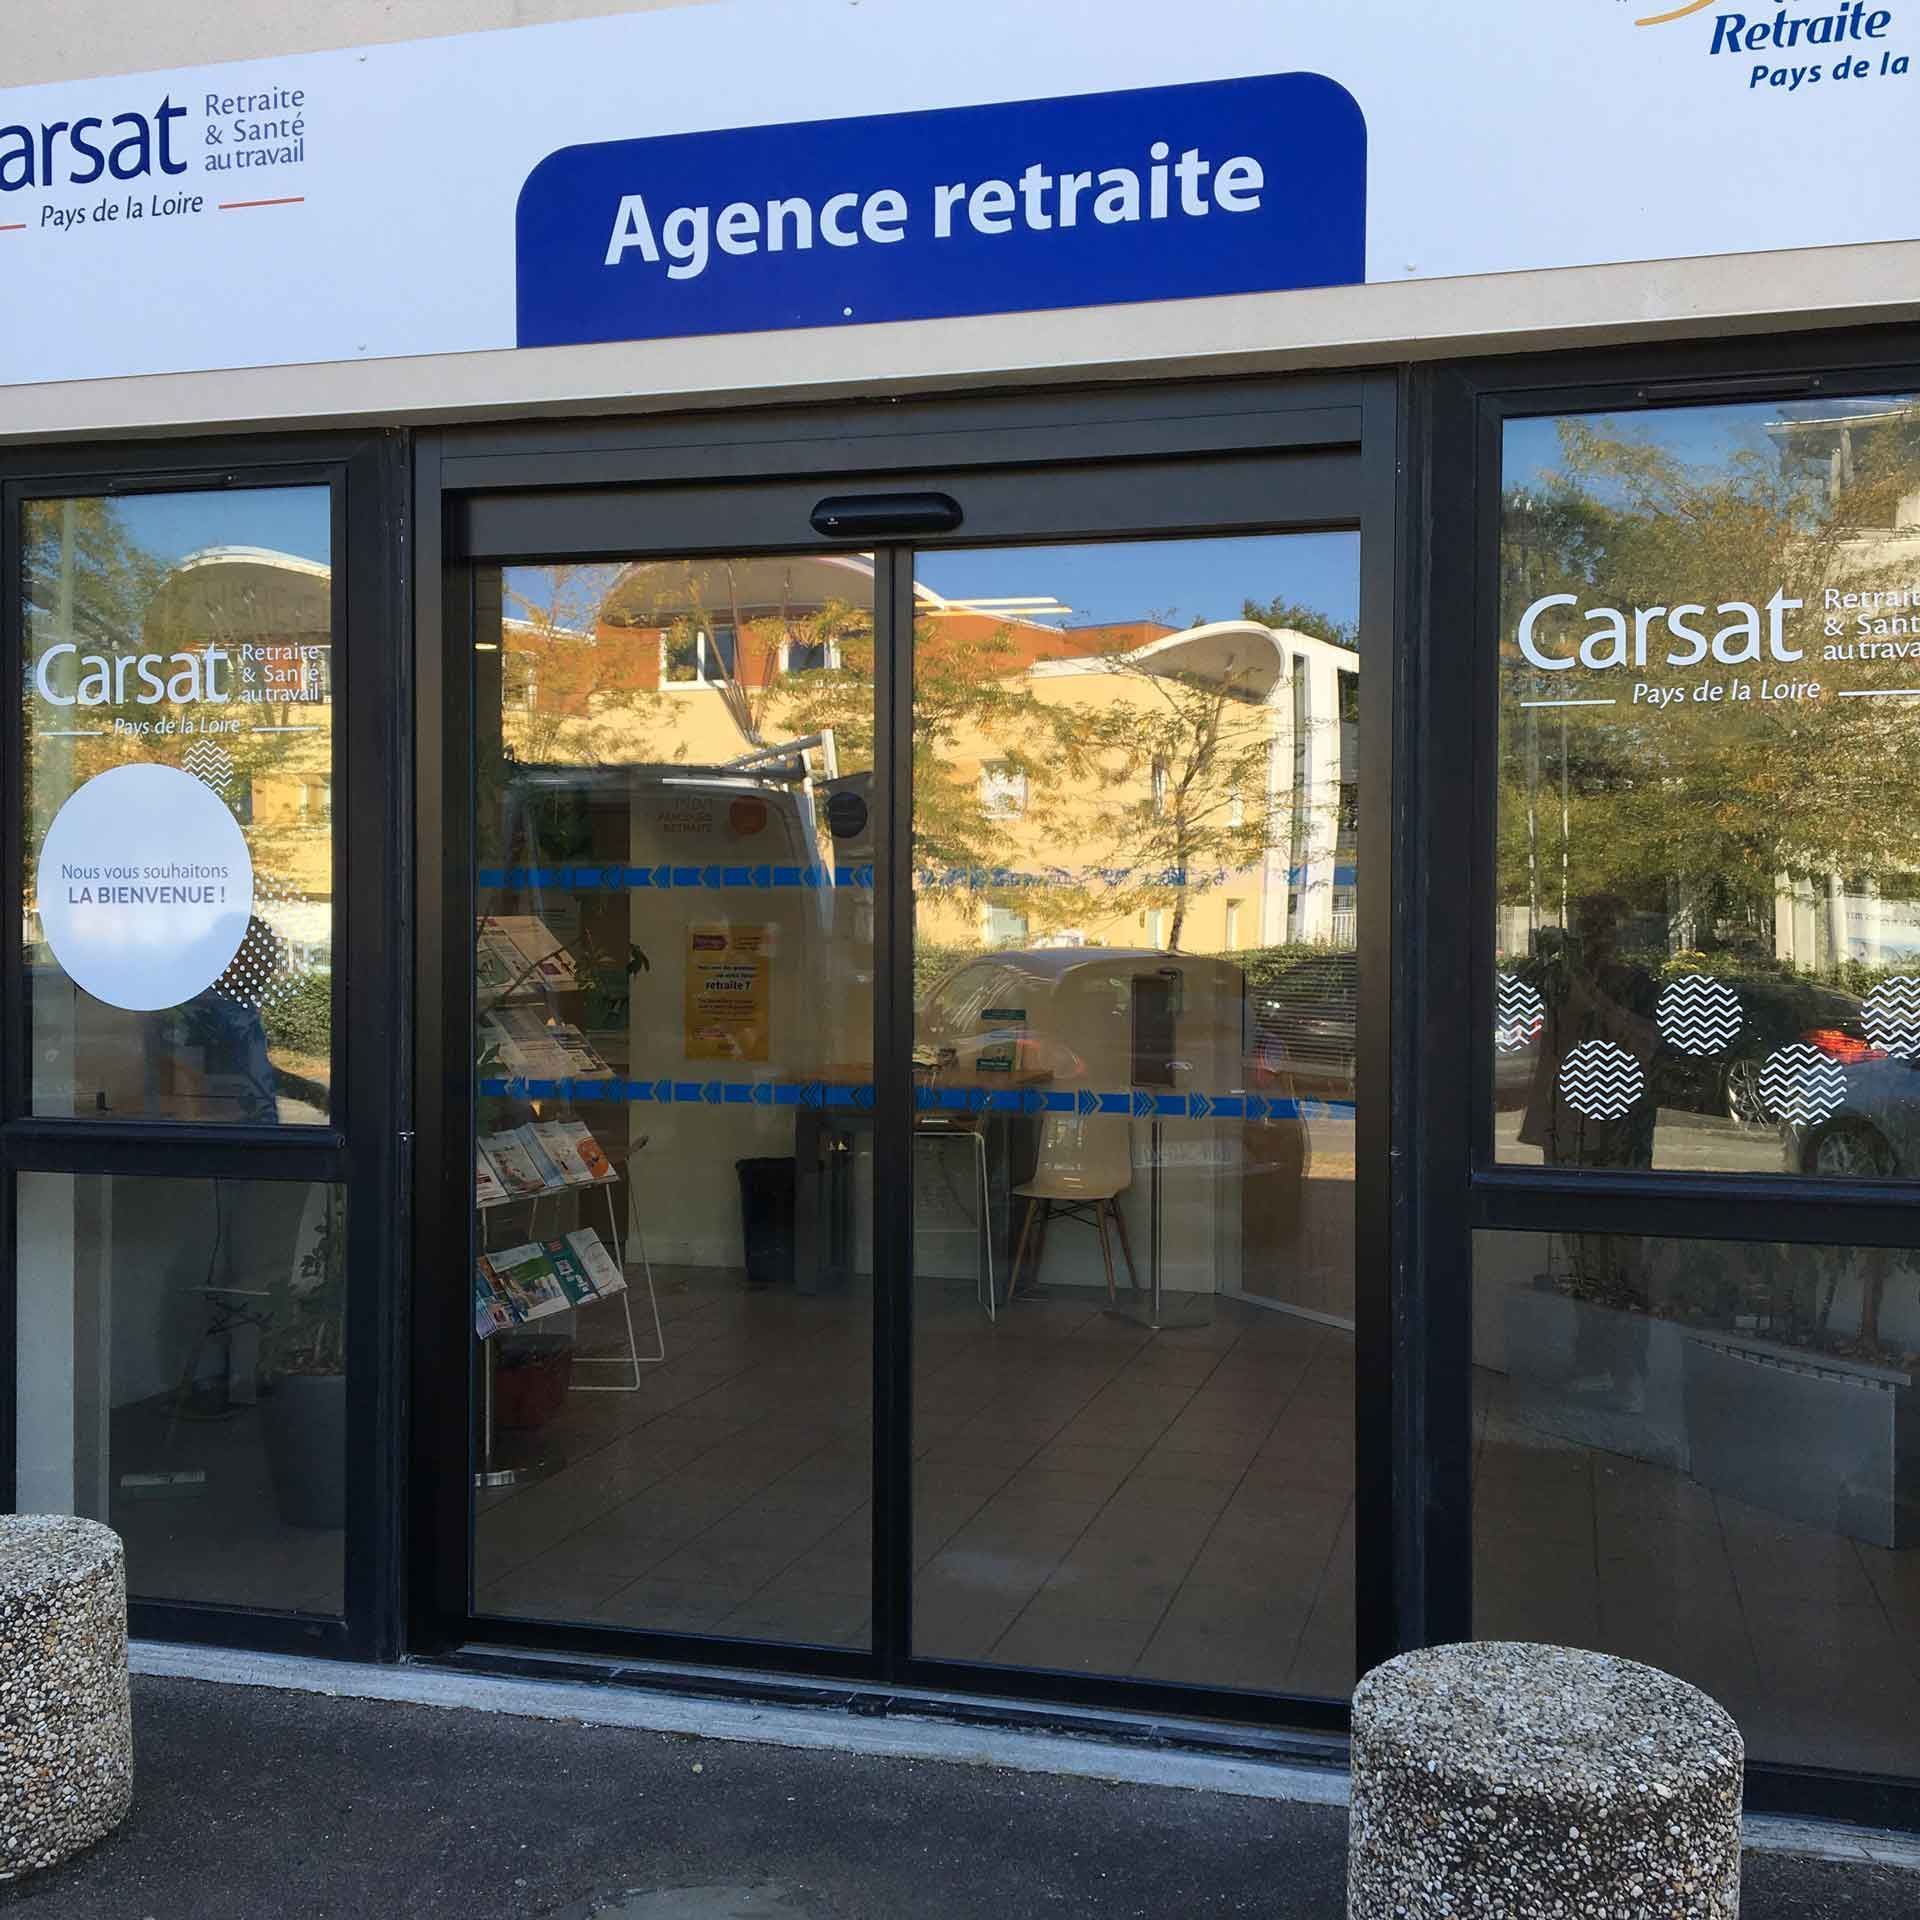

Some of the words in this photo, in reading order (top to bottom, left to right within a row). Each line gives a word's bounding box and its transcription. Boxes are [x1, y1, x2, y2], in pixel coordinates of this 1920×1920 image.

[1710, 1, 1892, 54] Retraite
[1750, 65, 1822, 91] Pays
[1832, 55, 1870, 81] de
[1880, 51, 1910, 76] la
[205, 87, 305, 117] Retraite
[205, 125, 223, 145] &
[233, 112, 305, 143] Santé
[41, 205, 86, 231] Pays
[93, 198, 119, 222] de
[126, 196, 144, 219] la
[151, 192, 204, 217] Loire
[604, 189, 908, 280] Agence
[934, 141, 1265, 238] retraite
[1518, 585, 1803, 671] Carsat
[1824, 617, 1844, 637] &
[242, 642, 319, 661] Retraite
[37, 642, 229, 706] Carsat
[242, 668, 256, 683] &
[264, 664, 319, 683] Santé
[1633, 683, 1685, 709] Pays
[1693, 680, 1723, 702] de
[1732, 679, 1751, 701] la
[1761, 677, 1821, 701] Loire
[114, 718, 149, 737] Pays
[154, 716, 176, 734] de
[180, 716, 194, 733] la
[200, 716, 240, 733] Loire
[62, 864, 100, 880] Nous
[103, 867, 139, 880] vous
[144, 862, 228, 879] souhaitons
[69, 887, 93, 904] LA
[98, 886, 215, 904] BIENVENUE
[705, 980, 744, 990] retraite
